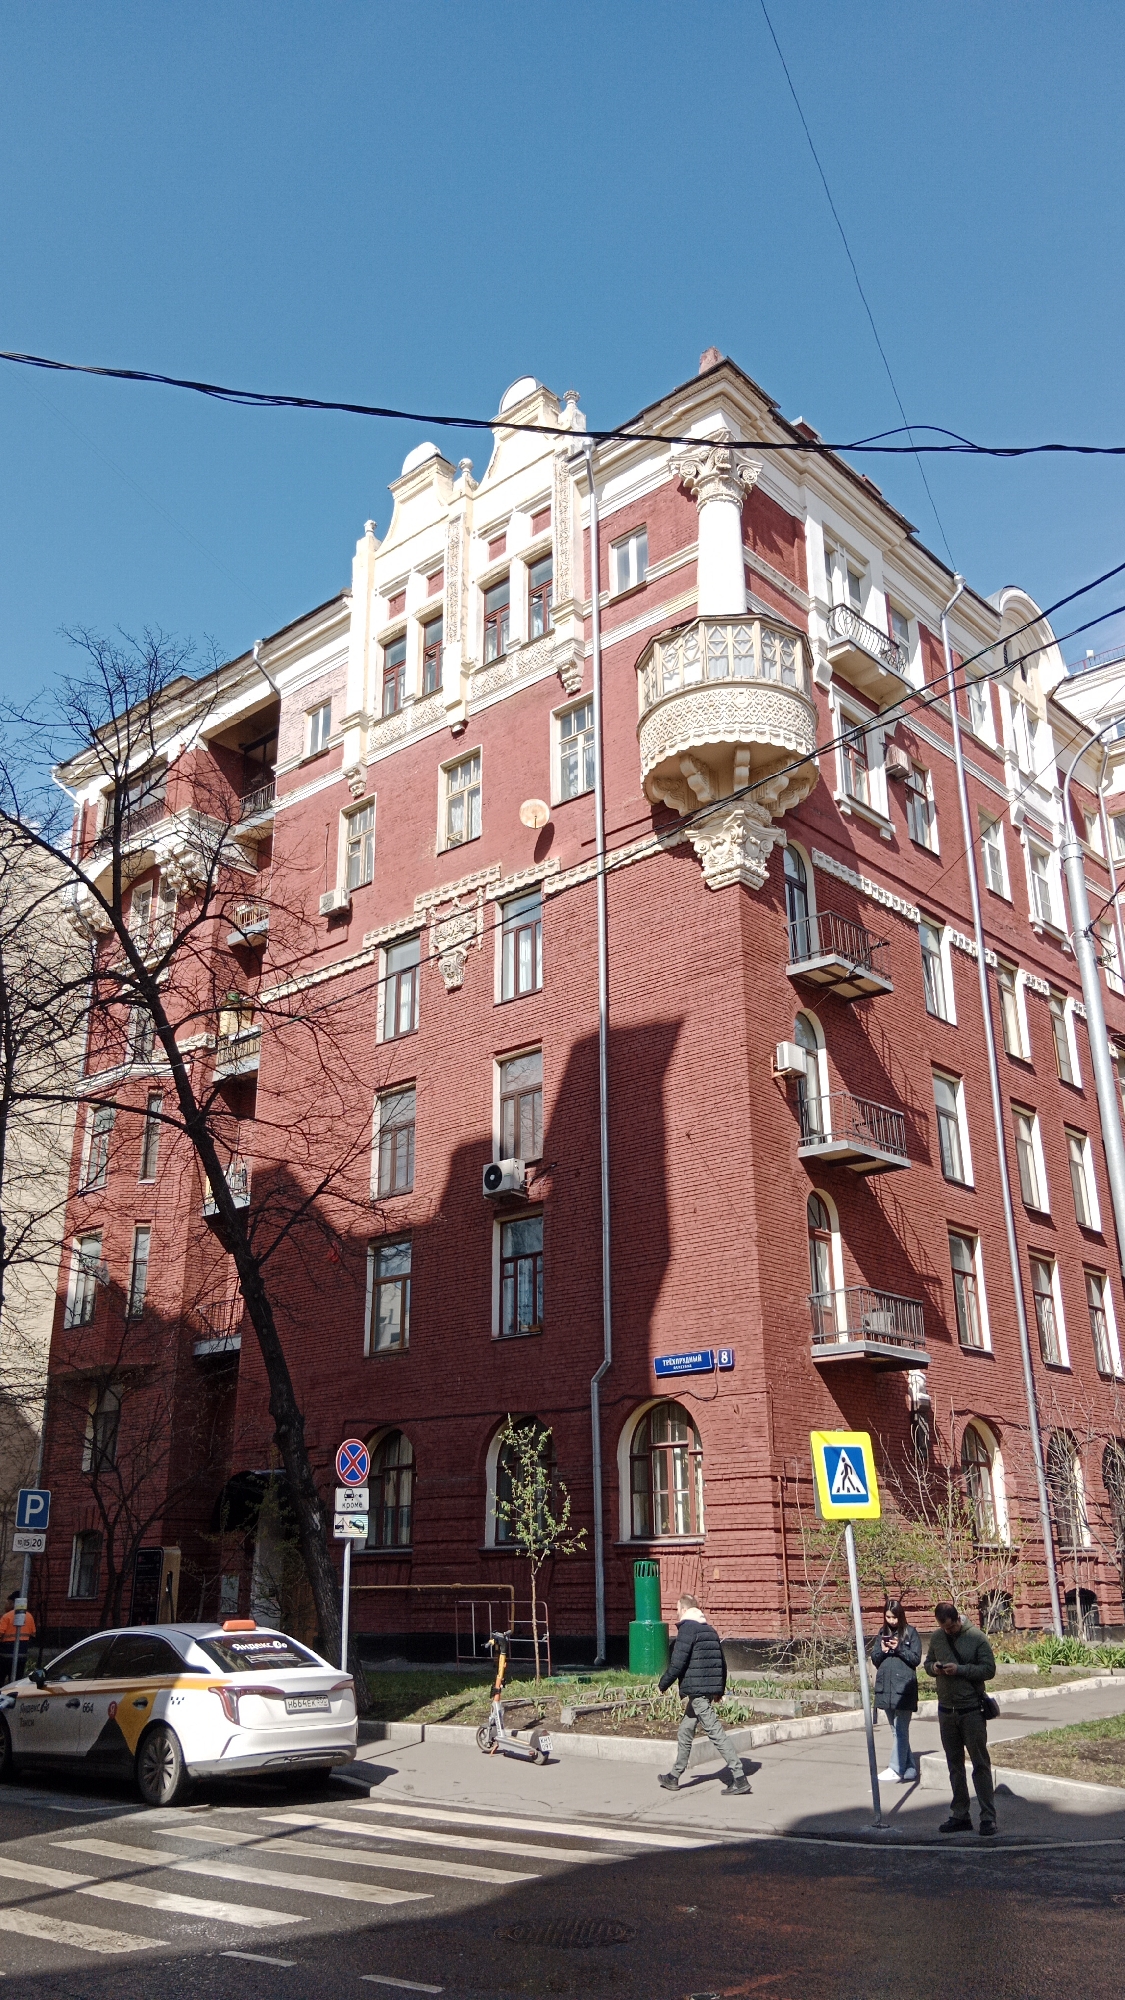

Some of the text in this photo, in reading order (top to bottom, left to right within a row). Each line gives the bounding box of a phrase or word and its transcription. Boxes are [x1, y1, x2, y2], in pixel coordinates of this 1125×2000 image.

[662, 1354, 702, 1367] ТРЁХПРУДНЫЙ
[721, 1351, 729, 1363] 8
[24, 1494, 45, 1524] P
[341, 1502, 363, 1510] кроме
[31, 1538, 42, 1548] 20
[82, 1702, 94, 1713] 664
